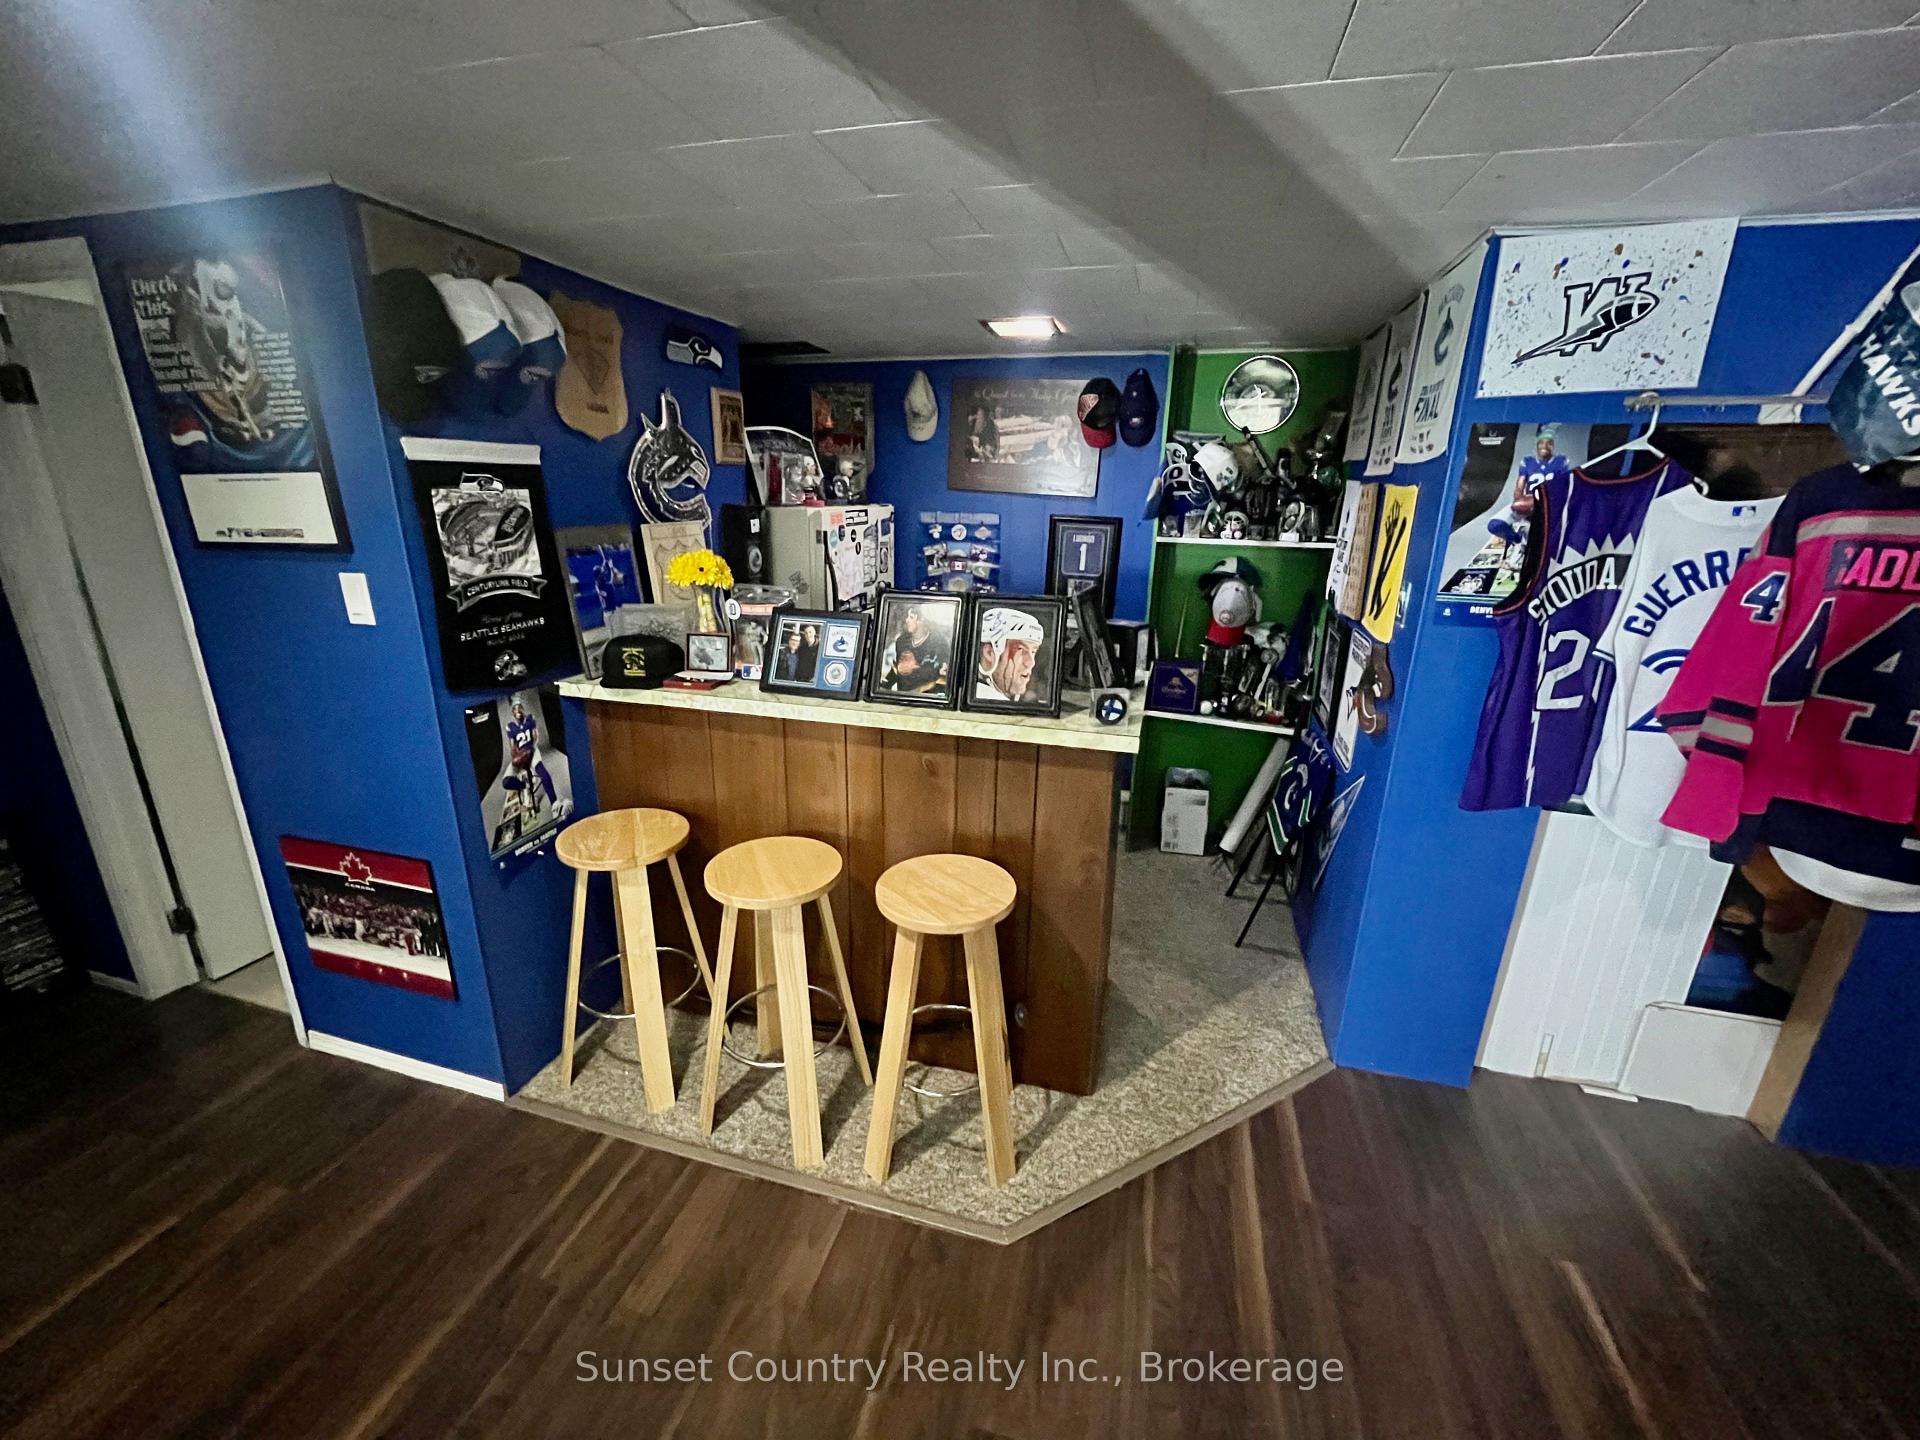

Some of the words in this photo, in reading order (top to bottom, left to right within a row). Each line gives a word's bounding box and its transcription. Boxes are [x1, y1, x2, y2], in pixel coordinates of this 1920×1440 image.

[1860, 333, 1920, 437] HAWKS
[1527, 556, 1624, 627] STOUDA
[1740, 570, 1791, 624] 4
[460, 626, 499, 642] SEATTLE
[500, 617, 545, 633] SEAHAWKS
